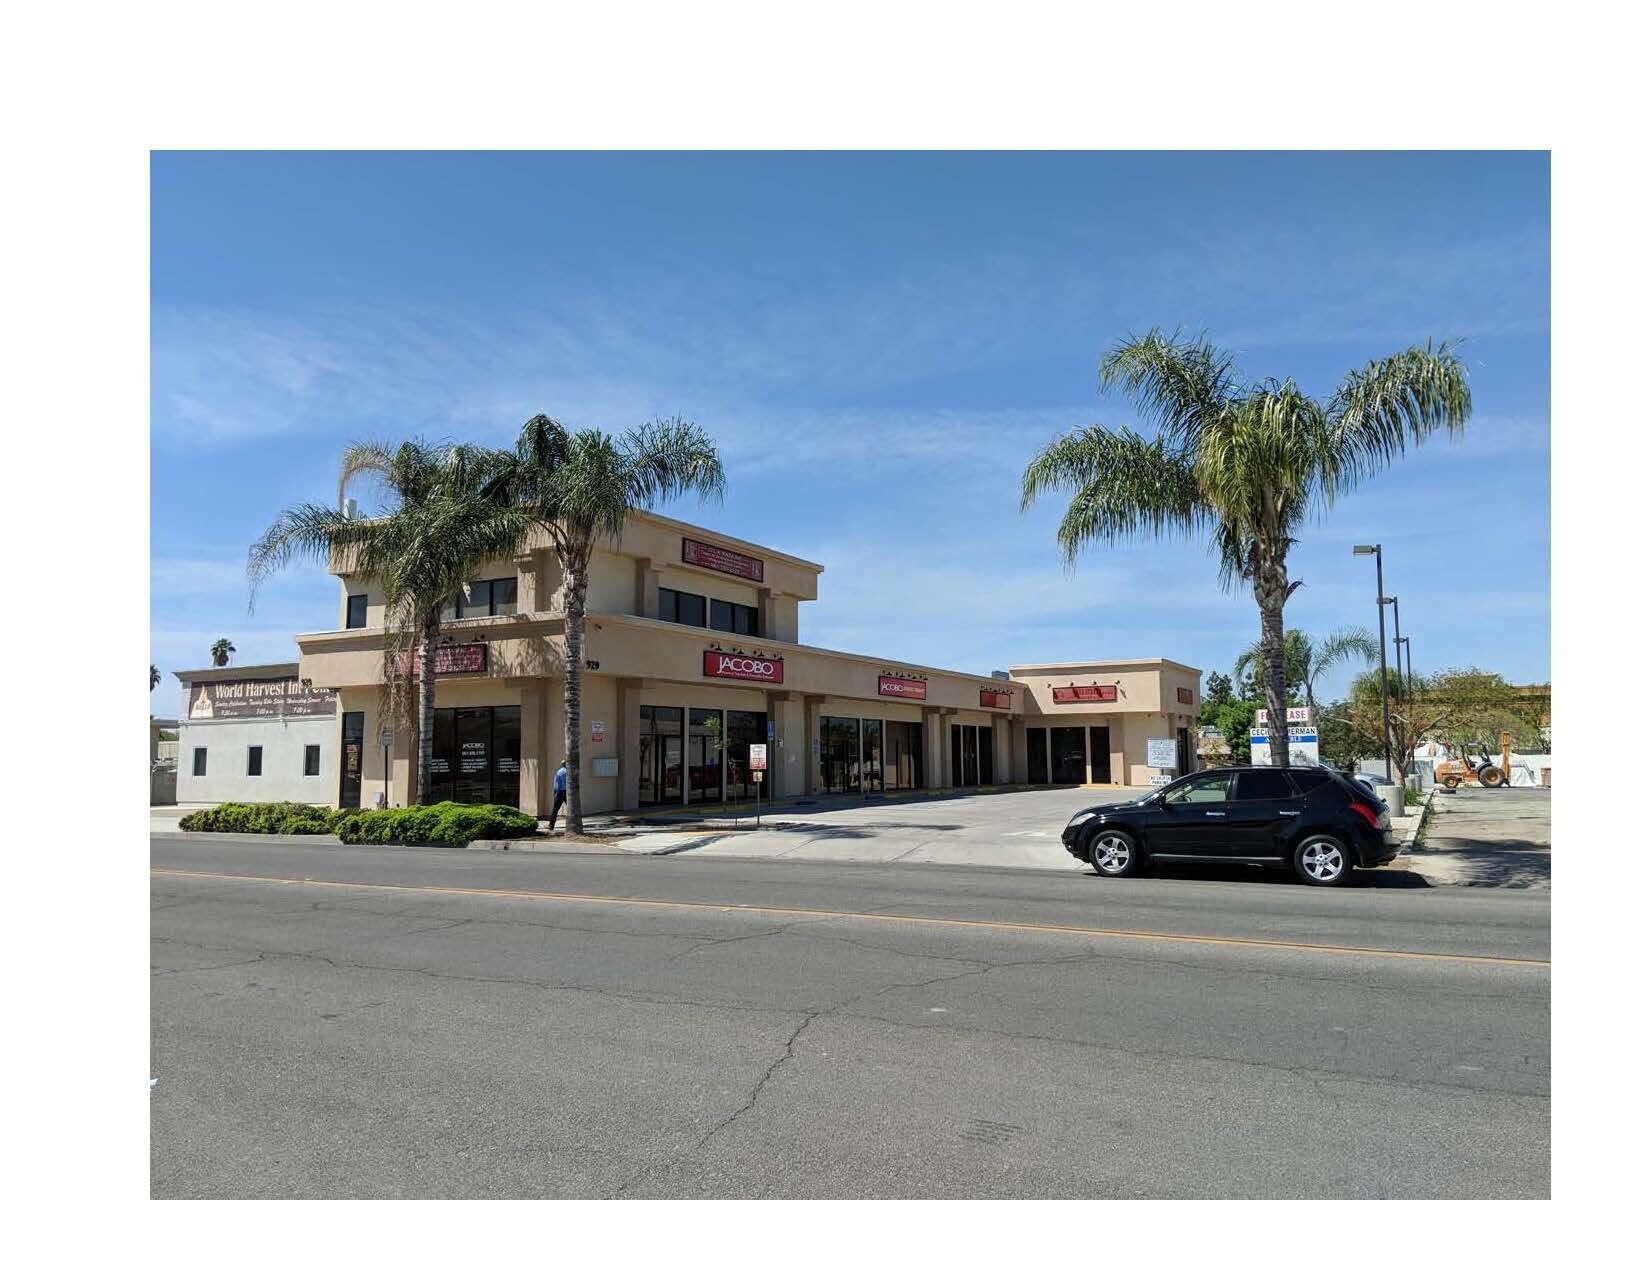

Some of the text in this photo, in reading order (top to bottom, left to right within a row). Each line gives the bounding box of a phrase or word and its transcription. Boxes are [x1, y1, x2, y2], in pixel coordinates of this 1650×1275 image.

[717, 656, 774, 675] JACOBO
[215, 683, 243, 699] World
[245, 681, 284, 697] Harvest
